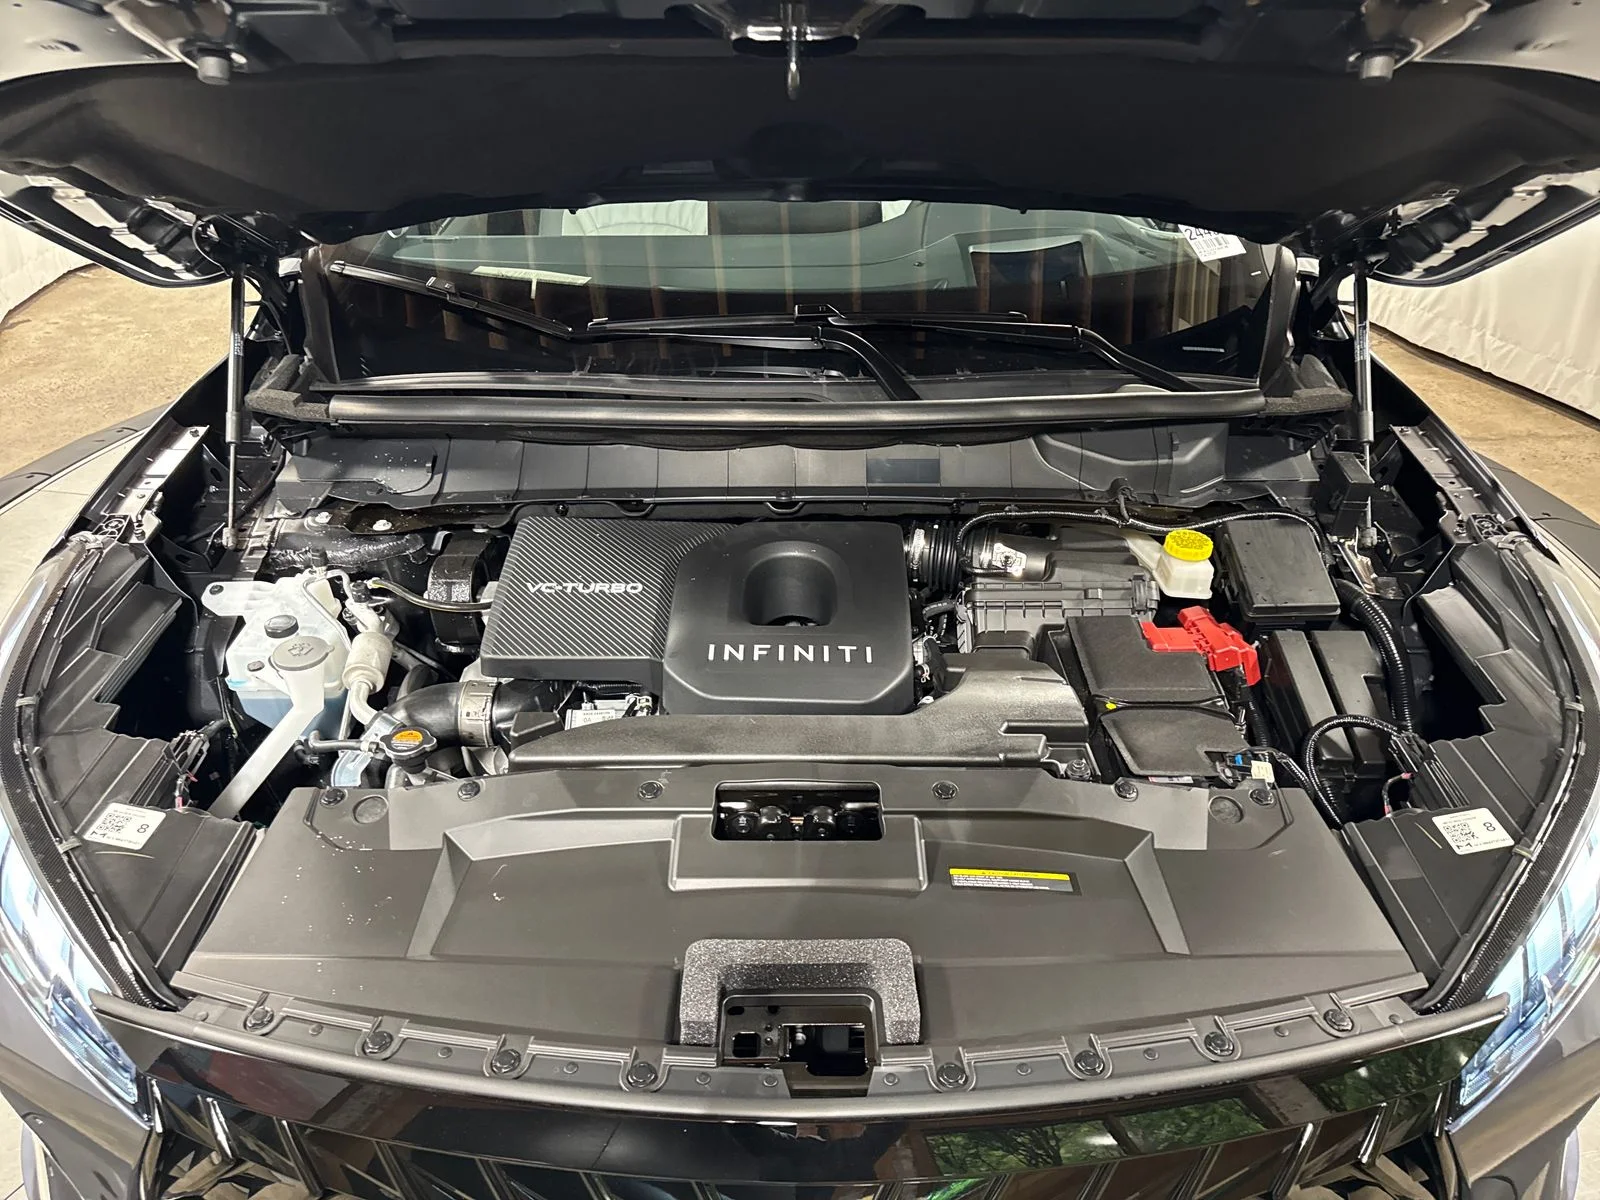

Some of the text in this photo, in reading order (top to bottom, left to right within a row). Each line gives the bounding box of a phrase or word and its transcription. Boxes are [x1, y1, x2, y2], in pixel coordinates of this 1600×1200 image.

[526, 582, 643, 594] VC-TURBO
[708, 644, 872, 663] INFINITI
[137, 823, 149, 834] 8
[1483, 821, 1496, 832] 8
